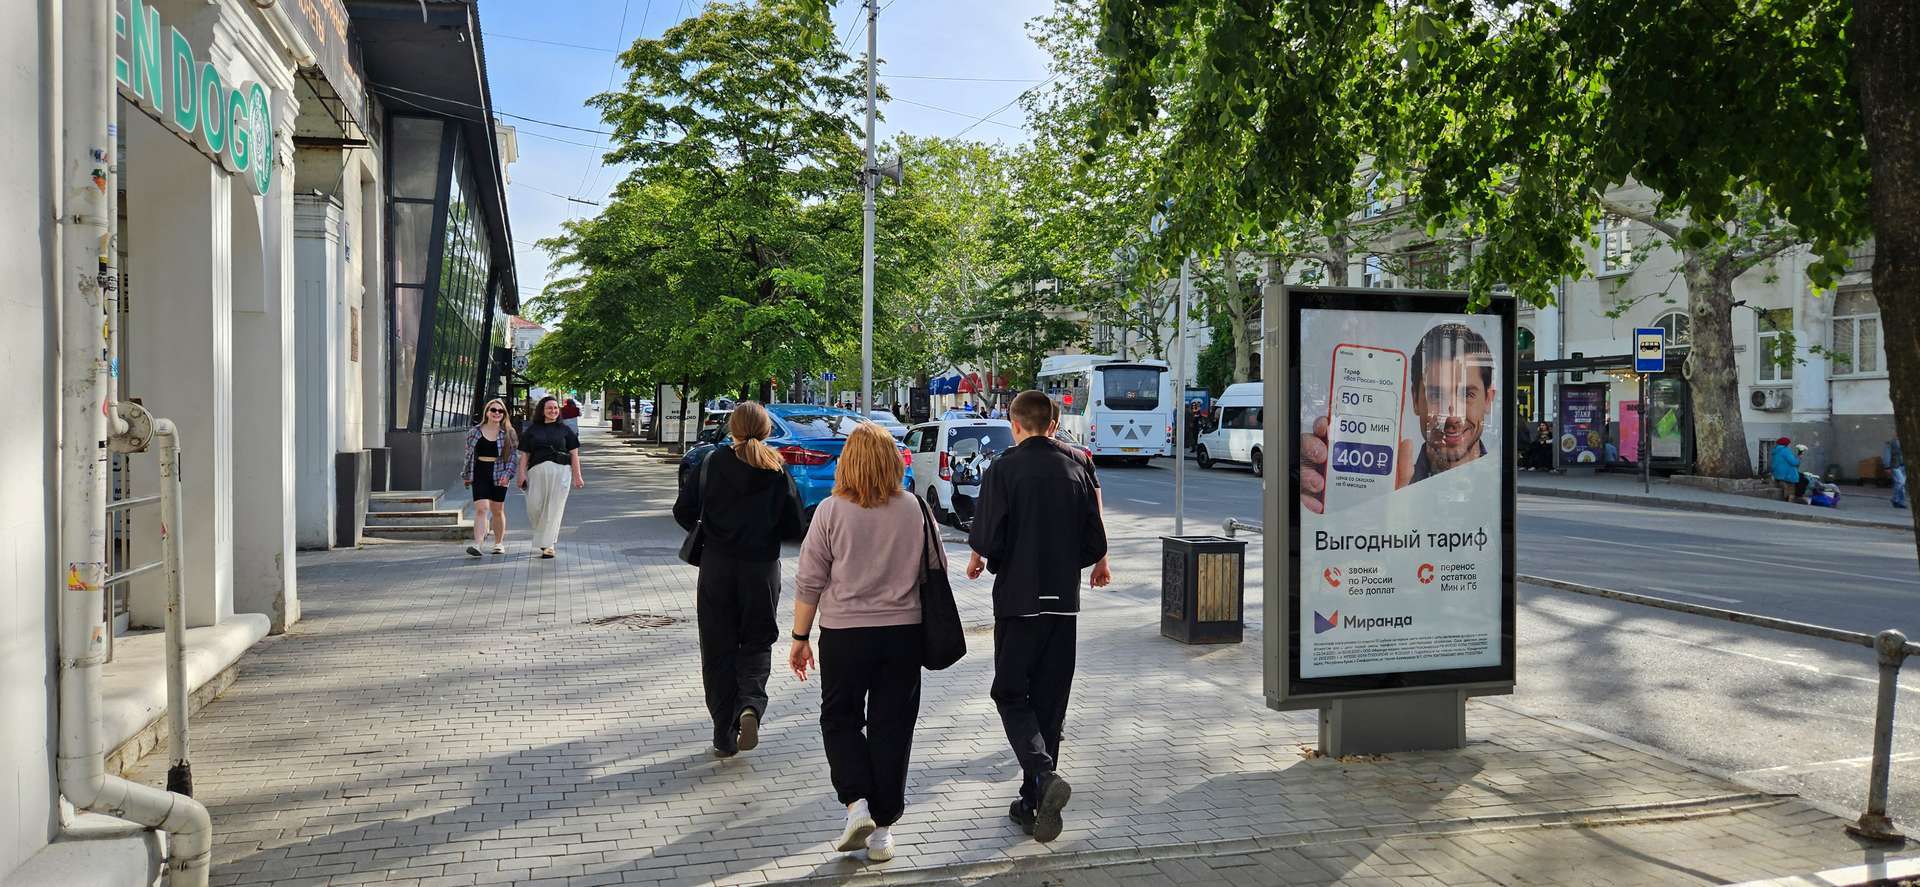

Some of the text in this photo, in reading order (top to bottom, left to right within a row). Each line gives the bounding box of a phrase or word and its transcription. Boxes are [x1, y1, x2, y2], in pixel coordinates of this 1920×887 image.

[171, 25, 250, 172] DOG
[1342, 392, 1373, 405] 50 ГБ
[1340, 420, 1390, 434] 500 МИН
[1337, 449, 1374, 468] 400
[1315, 527, 1488, 552] Выгодный тариф
[1348, 567, 1378, 575] звонки
[1440, 563, 1475, 573] перенос
[1348, 575, 1393, 585] по России
[1440, 573, 1477, 582] остатков
[1348, 586, 1395, 597] без доплат
[1440, 583, 1458, 592] Мин
[1467, 581, 1478, 590] Гб
[1343, 615, 1413, 631] Миранда
